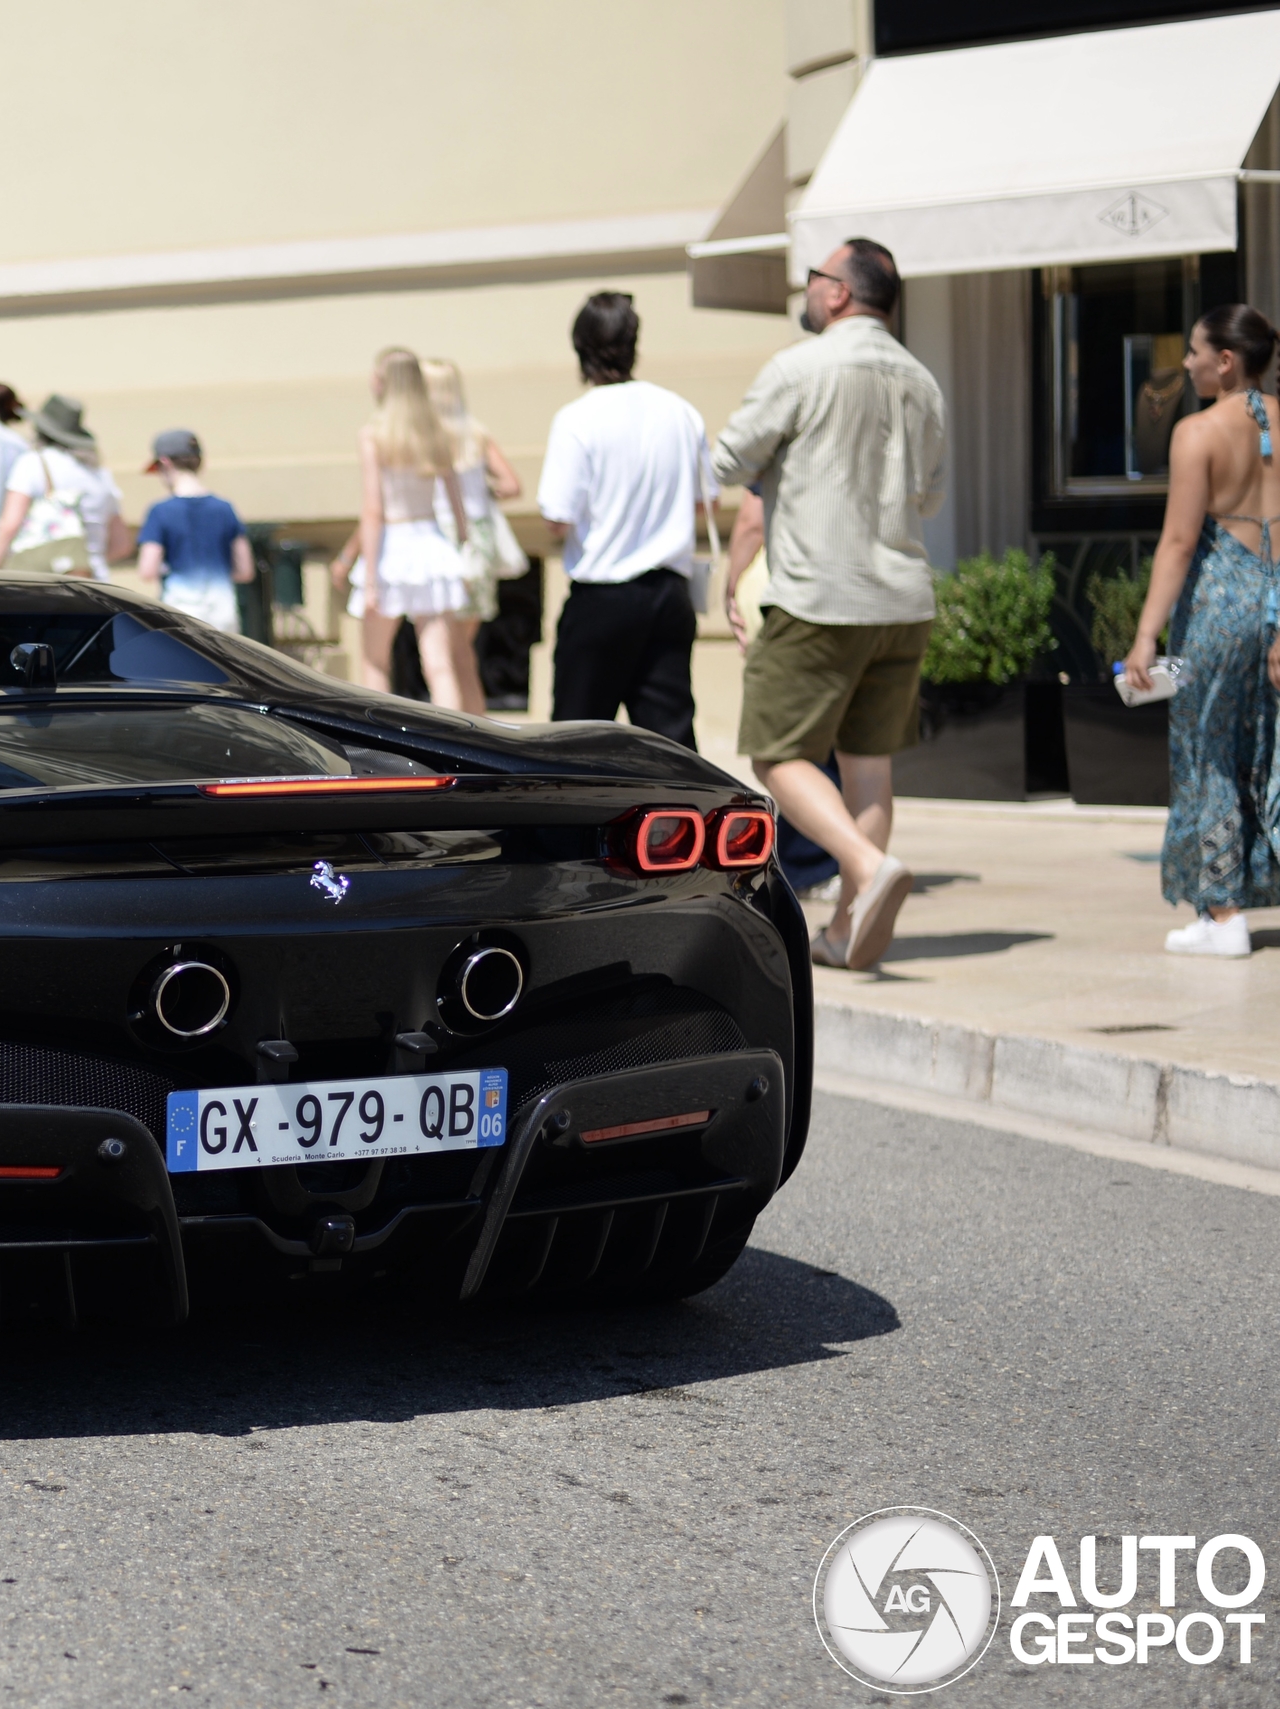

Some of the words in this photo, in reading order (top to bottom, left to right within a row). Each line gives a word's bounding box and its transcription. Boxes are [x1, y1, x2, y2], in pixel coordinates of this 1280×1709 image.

[481, 1112, 502, 1137] 06
[176, 1140, 187, 1156] F
[271, 1154, 301, 1163] Scuderia
[304, 1152, 326, 1161] Monte
[327, 1151, 345, 1159] Carlo
[354, 1149, 370, 1157] +377
